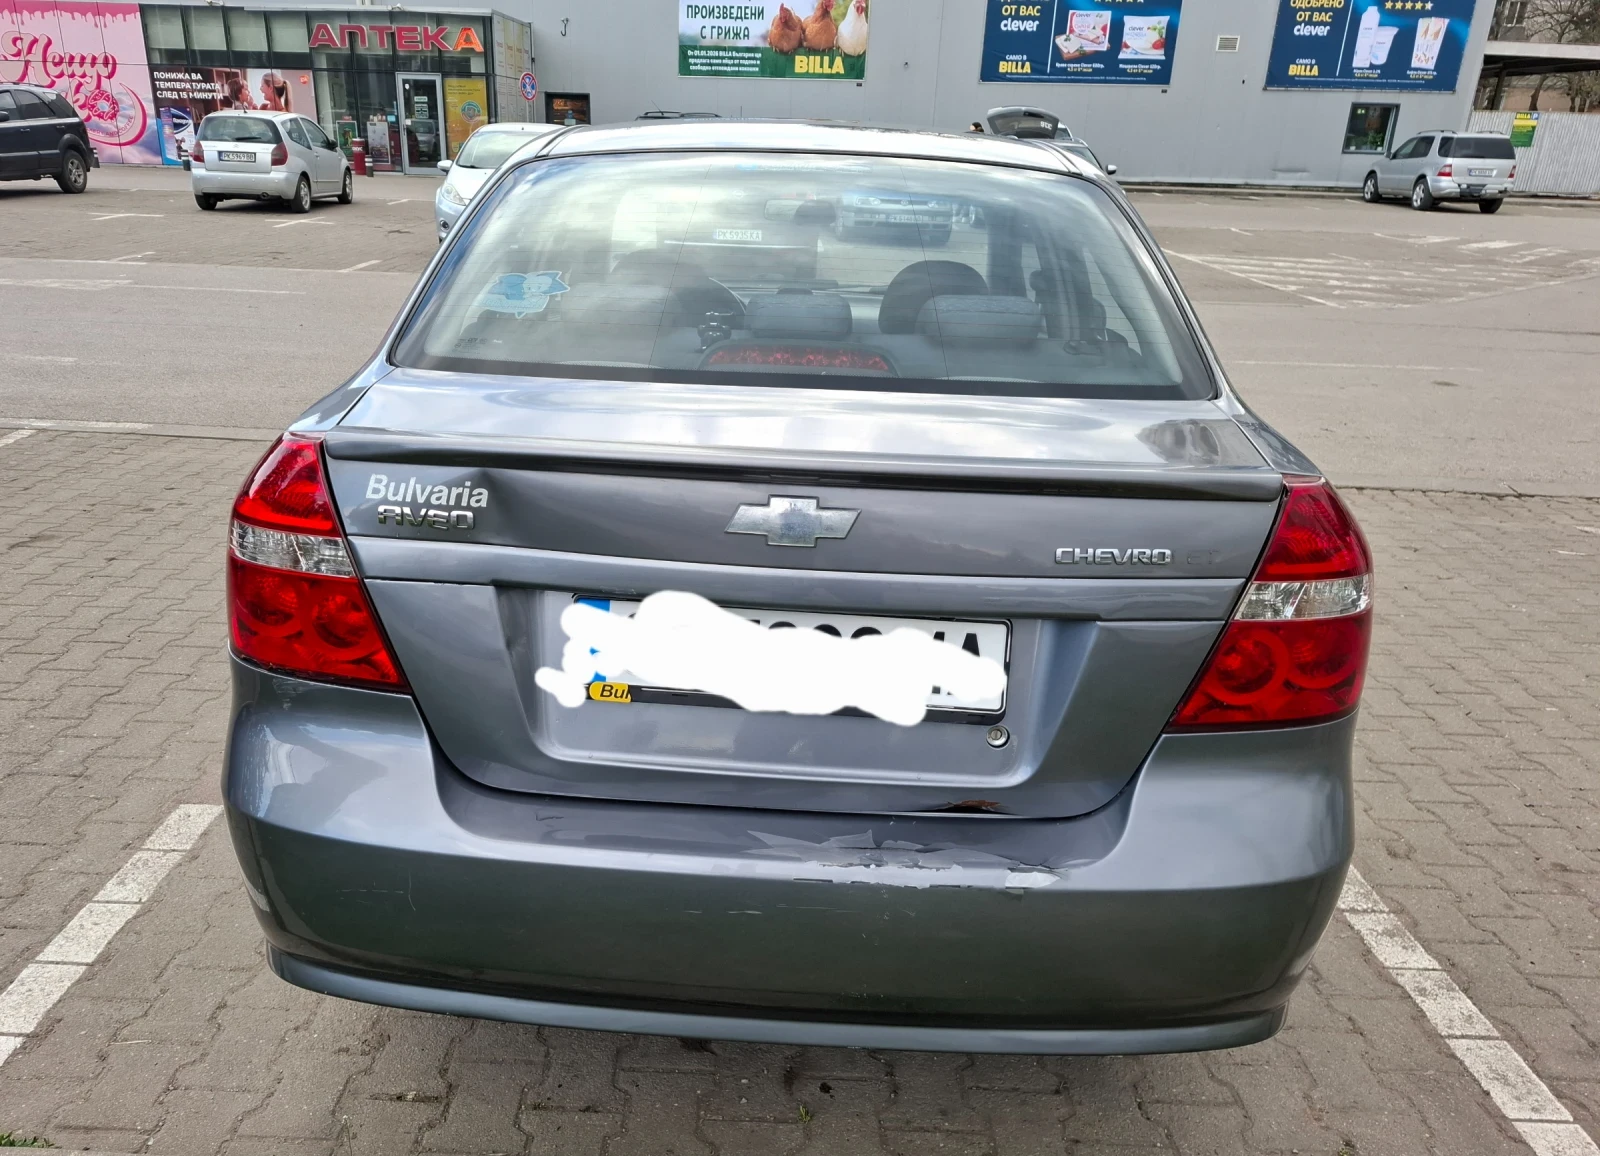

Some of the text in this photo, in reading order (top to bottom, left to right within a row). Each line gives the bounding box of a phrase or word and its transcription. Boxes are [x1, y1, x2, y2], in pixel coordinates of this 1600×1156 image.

[686, 4, 764, 21] ПРОИЗВЕДЕНИ
[1002, 5, 1041, 16] ОТ ВАС
[1296, 11, 1333, 22] ОТ ВАС
[1000, 17, 1039, 31] clever
[1293, 23, 1331, 36] clever
[308, 23, 485, 52] АПТЕКА
[700, 25, 750, 40] С ГРИЖА
[794, 55, 845, 74] BILLA
[998, 61, 1031, 73] BILLA
[1288, 64, 1319, 76] BILLA
[156, 90, 179, 99] СЛЕД
[189, 92, 224, 100] МИНУТИ
[365, 473, 489, 508] Bulvaria
[377, 504, 475, 530] AVEO
